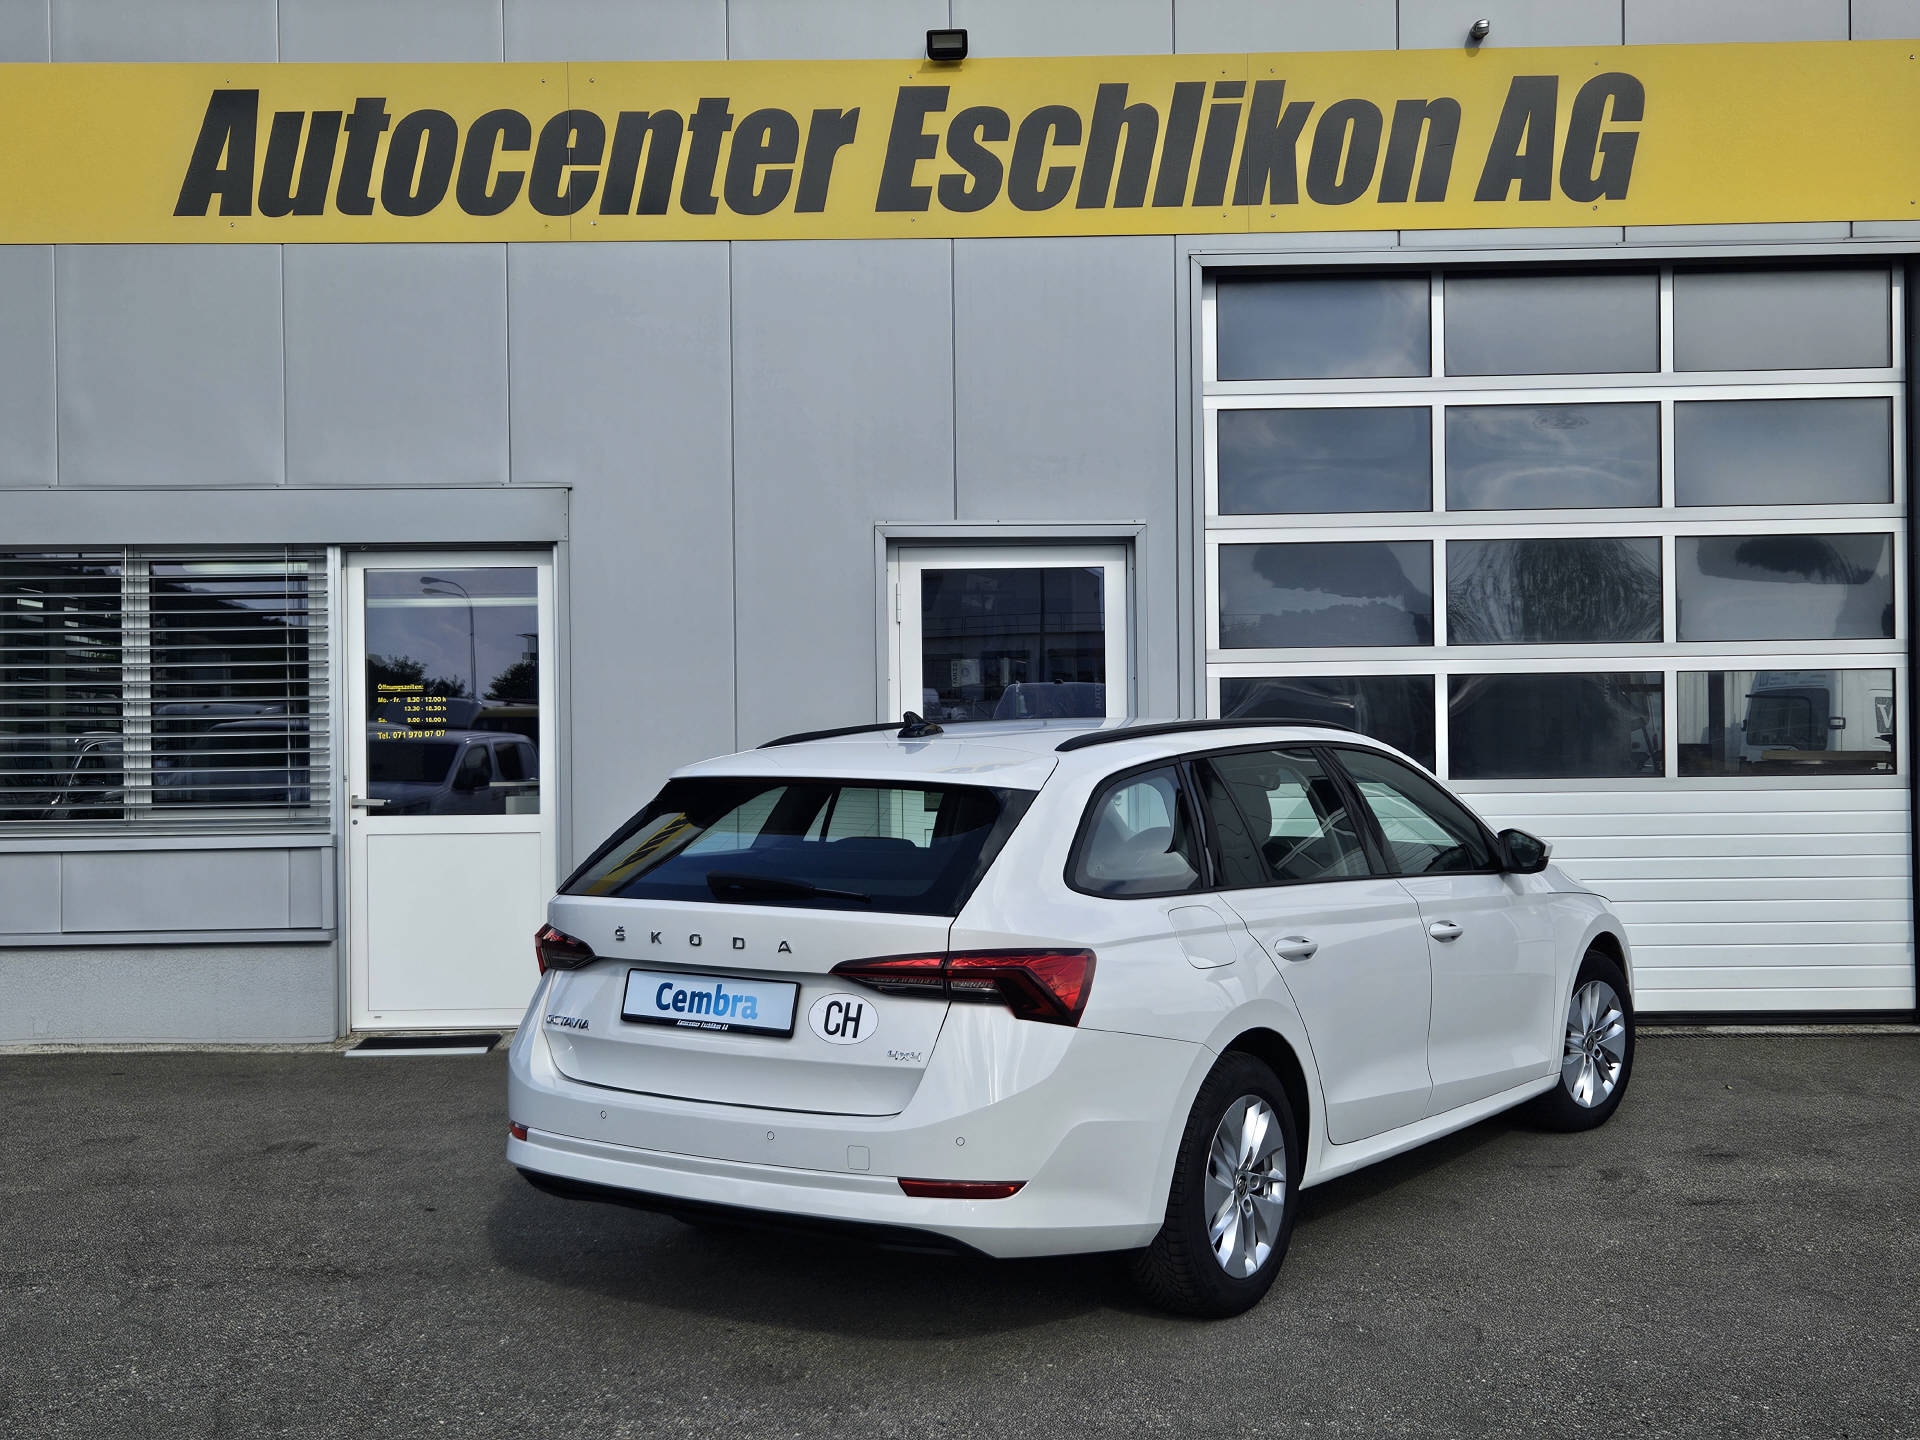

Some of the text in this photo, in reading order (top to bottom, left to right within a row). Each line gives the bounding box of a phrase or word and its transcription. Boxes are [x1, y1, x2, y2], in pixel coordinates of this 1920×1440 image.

[173, 72, 1646, 217] Autocenter Eschlikon AG
[377, 729, 446, 740] Tel. 071 970 07 07
[614, 925, 792, 954] ŠKODA
[655, 982, 758, 1020] Cembra
[546, 1014, 589, 1031] OCTAVIA
[824, 1000, 863, 1039] CH
